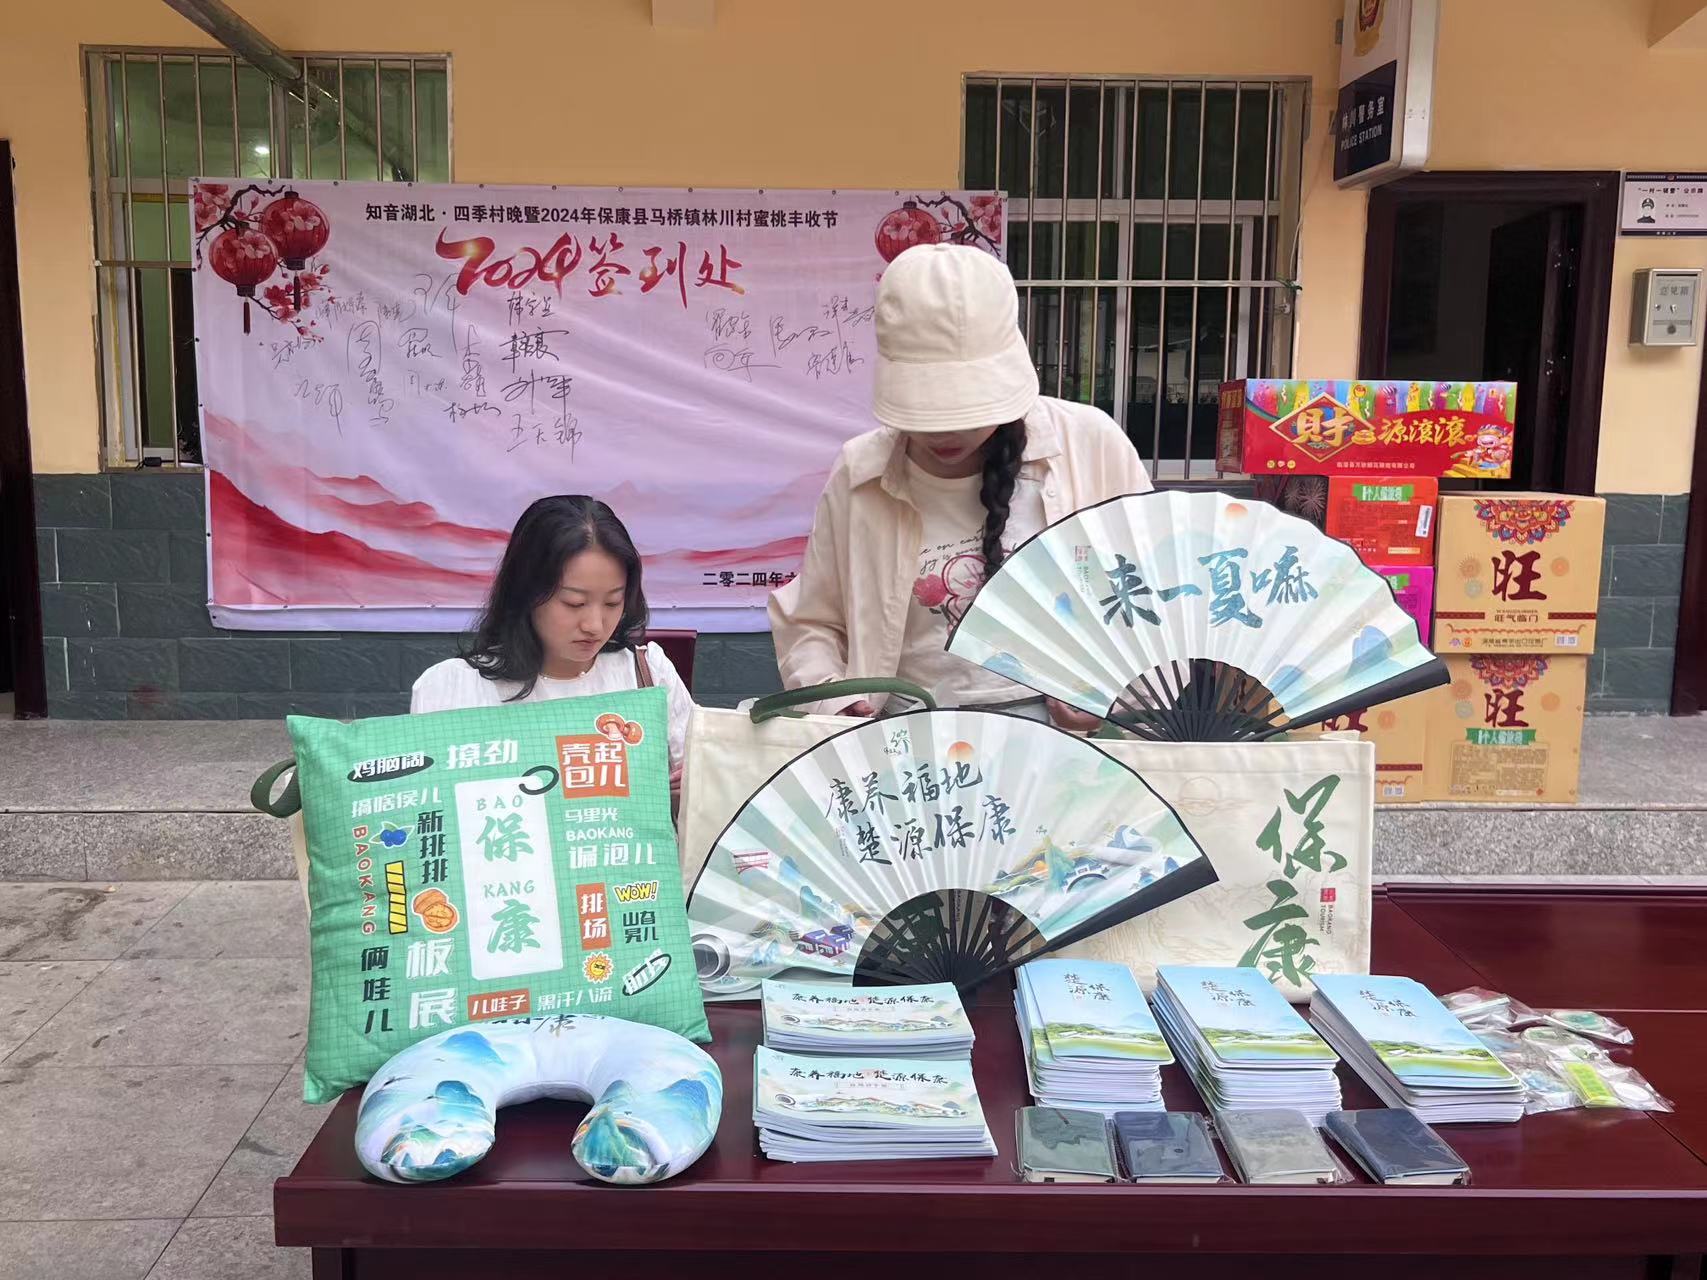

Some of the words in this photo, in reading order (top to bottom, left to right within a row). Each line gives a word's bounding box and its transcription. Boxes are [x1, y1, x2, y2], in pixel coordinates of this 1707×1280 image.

[1359, 124, 1382, 144] STATION
[365, 203, 839, 229] 知音湖北·四季村晚暨2024年保康县马桥镇林川村蜜桃丰收节
[1099, 545, 1320, 630] 来一夏嘛
[1491, 550, 1547, 602] 旺
[1485, 688, 1529, 728] 旺
[476, 795, 524, 811] BAO
[825, 761, 983, 823] 康养福地
[475, 812, 535, 862] 保
[566, 827, 634, 841] BAOKANG
[856, 794, 1016, 865] 楚源保康
[352, 826, 376, 935] BAOKANG
[483, 880, 535, 899] KANG
[614, 882, 657, 902] WOW!
[486, 899, 541, 954] 康
[472, 995, 527, 1016] 儿娃子
